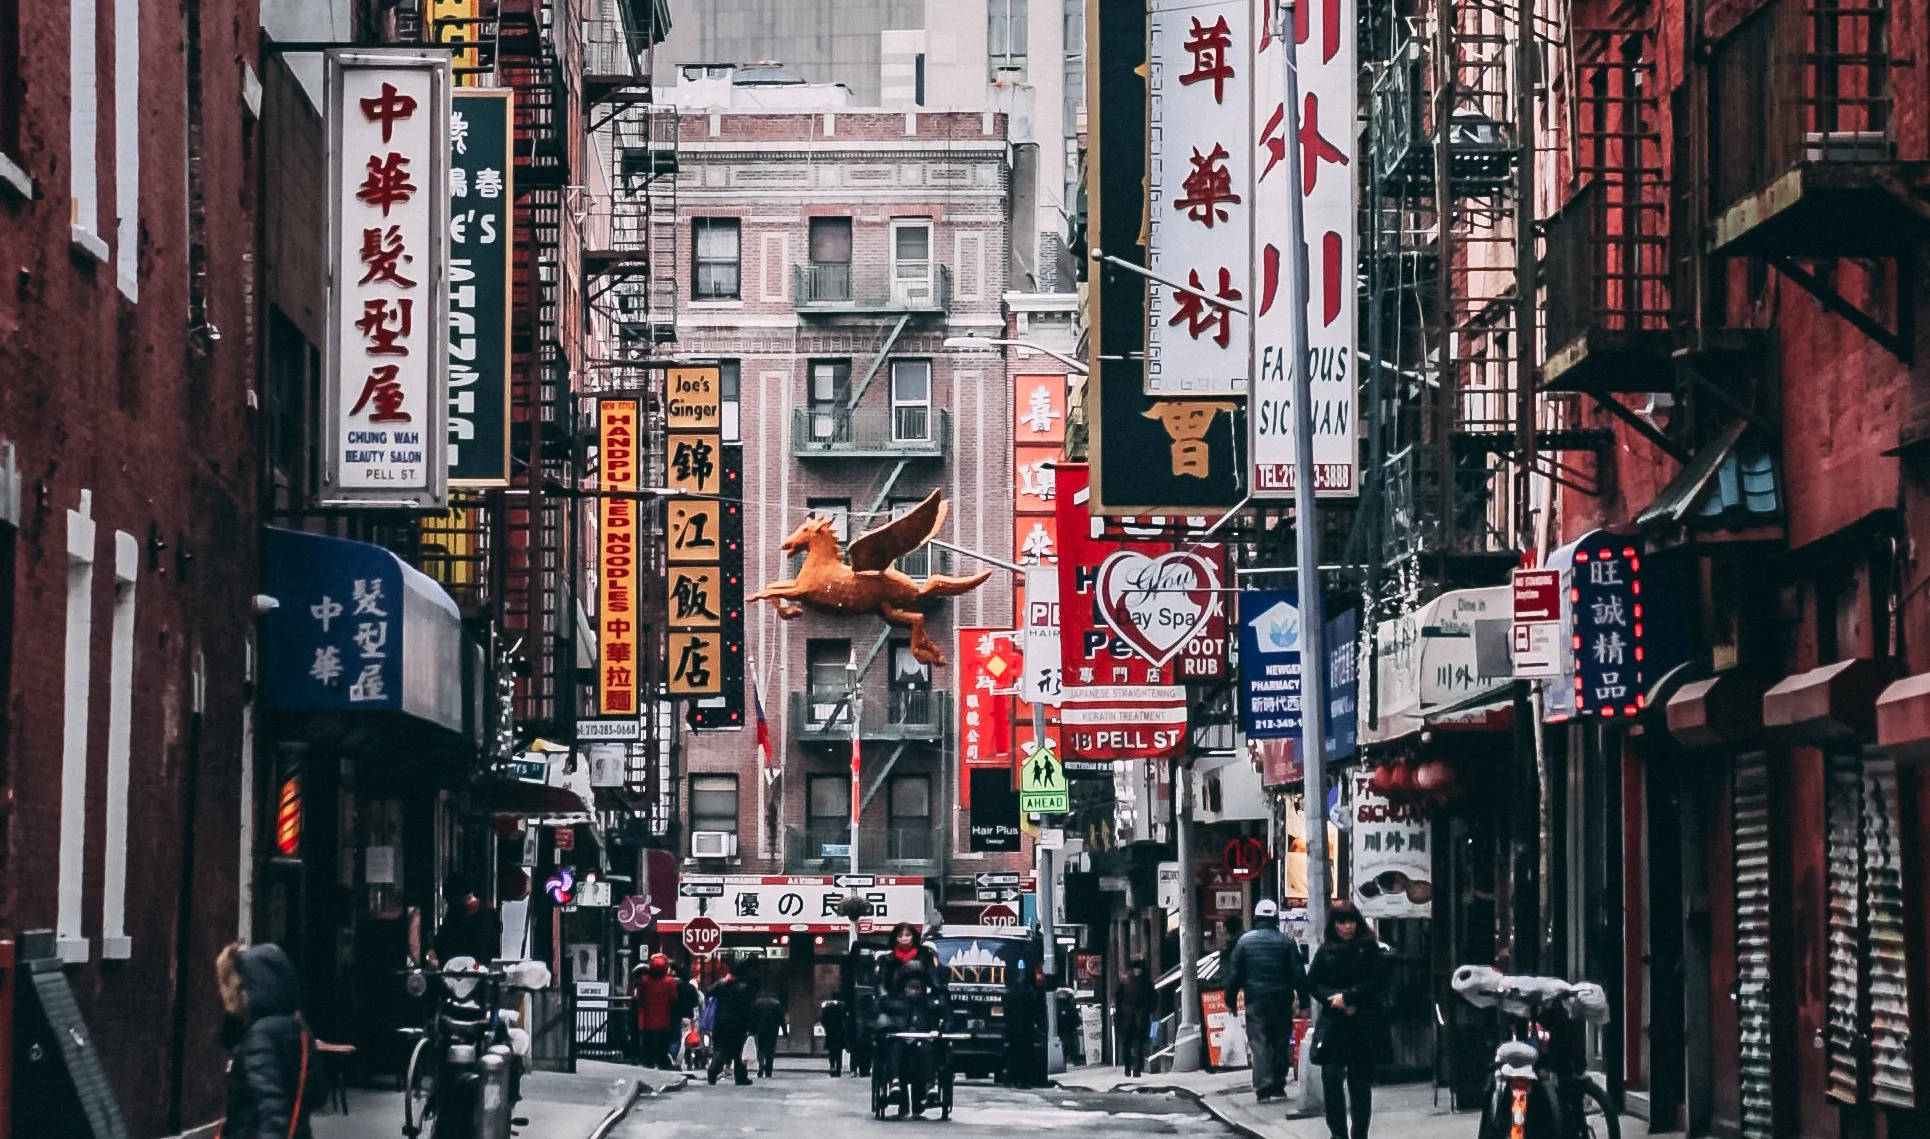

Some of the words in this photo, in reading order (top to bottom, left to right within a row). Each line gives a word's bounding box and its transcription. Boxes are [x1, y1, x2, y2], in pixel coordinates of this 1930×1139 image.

[1261, 345, 1348, 383] FAOUS
[676, 375, 710, 393] Joe's
[669, 399, 718, 421] Ginger
[348, 431, 388, 444] CHUNG
[394, 432, 419, 444] WAH
[345, 450, 385, 463] BEAUTY
[390, 450, 422, 463] SALON
[366, 469, 394, 480] PELL
[669, 438, 719, 687] 錦江飯店
[605, 533, 631, 613] NOODLES
[1158, 607, 1197, 631] Spa
[1185, 659, 1218, 675] RUB
[1070, 687, 1110, 699] JAPANESE
[1251, 680, 1300, 692] PHARMACY
[1251, 695, 1303, 713] 新時代西
[1082, 711, 1116, 722] KERATIN
[1119, 711, 1165, 721] TREATMENT
[1097, 731, 1148, 749] PELL
[1154, 730, 1180, 749] ST
[1027, 797, 1063, 809] AHEAD
[972, 825, 993, 836] Hair
[996, 825, 1019, 835] Plus
[686, 929, 719, 944] STOP
